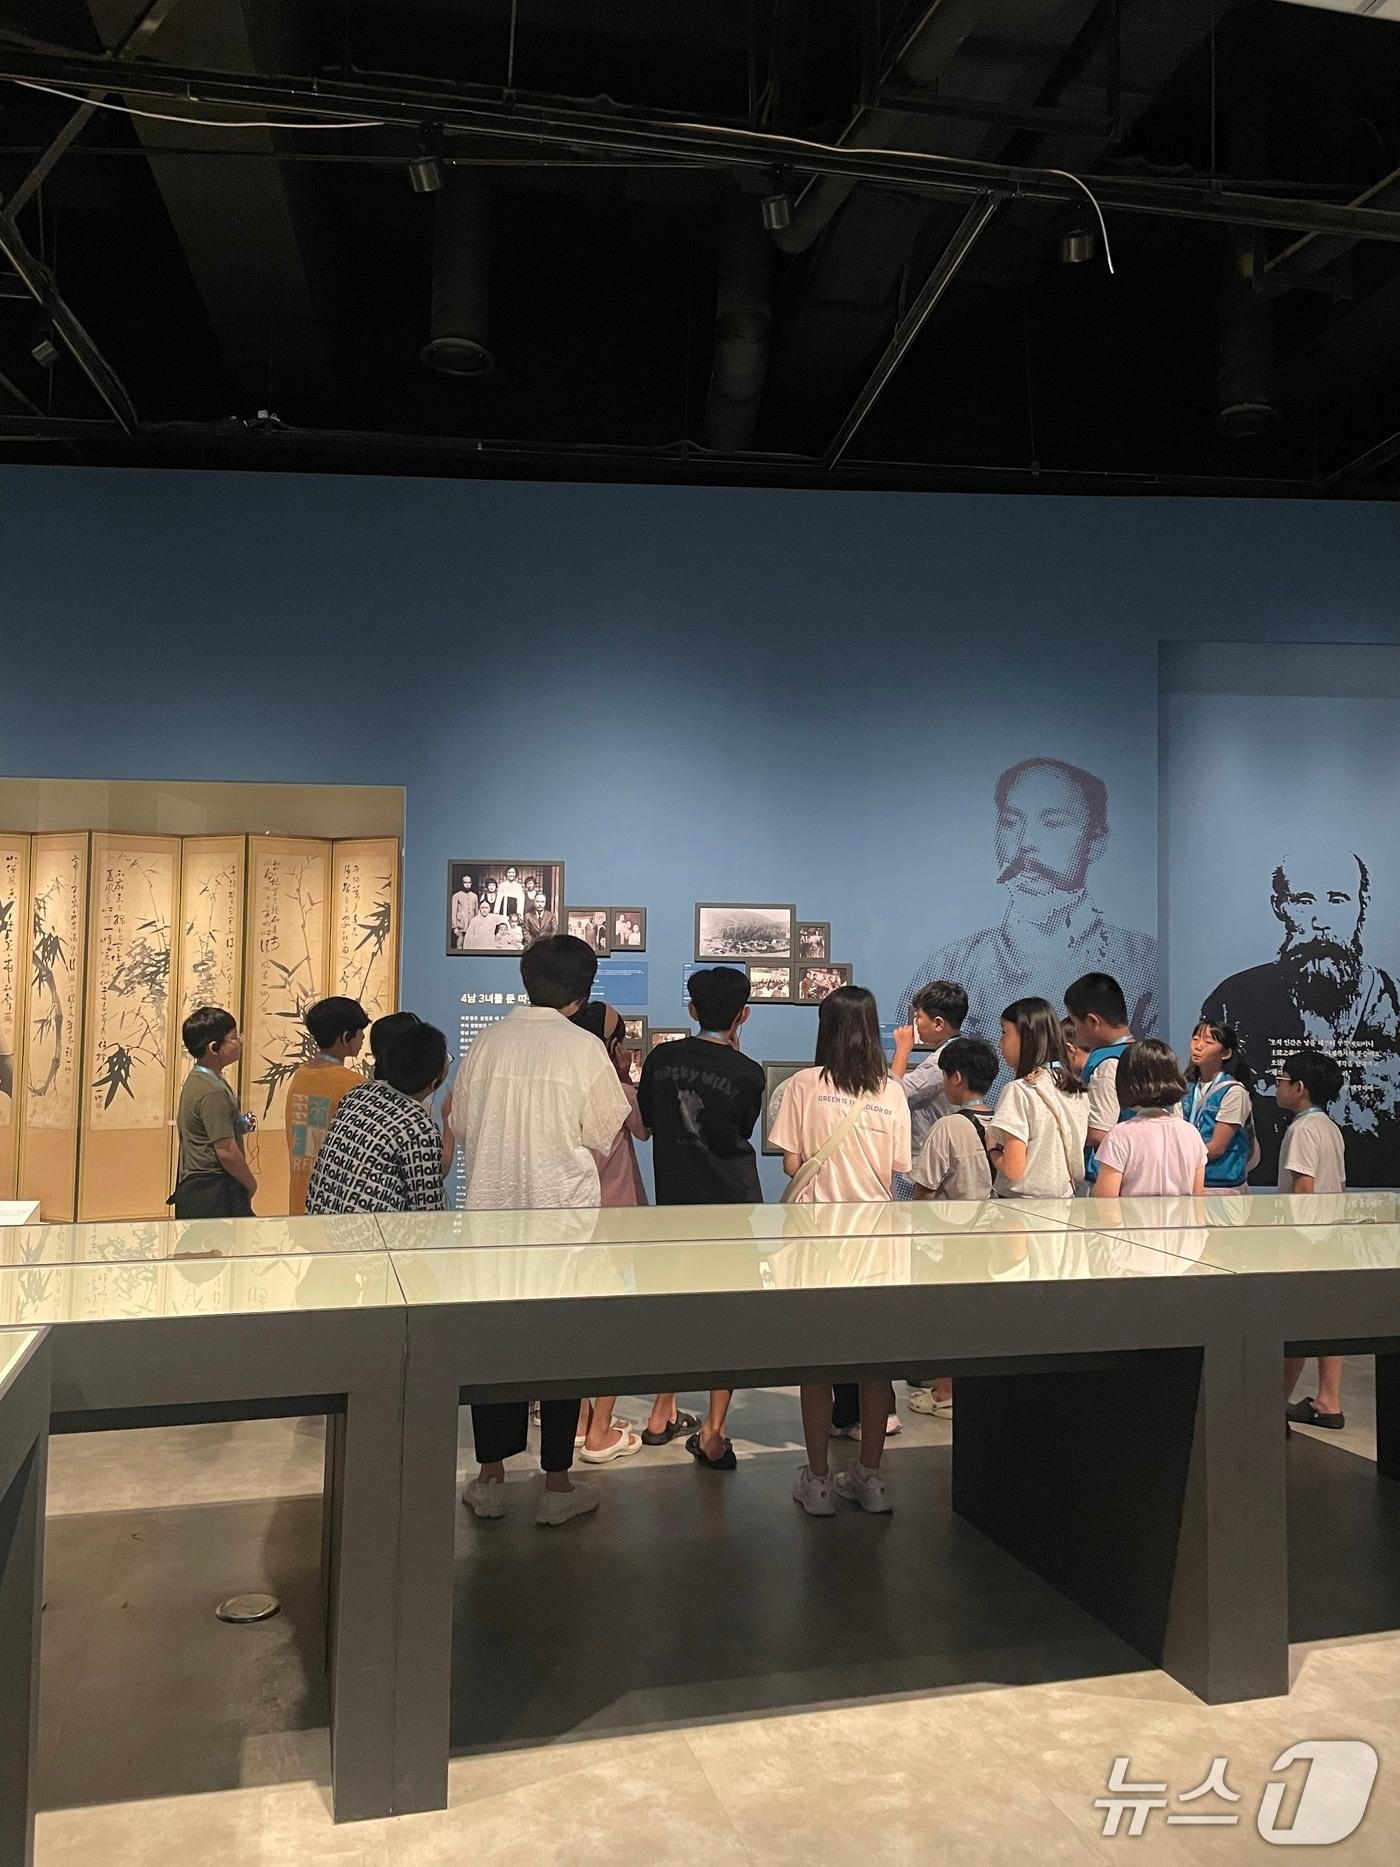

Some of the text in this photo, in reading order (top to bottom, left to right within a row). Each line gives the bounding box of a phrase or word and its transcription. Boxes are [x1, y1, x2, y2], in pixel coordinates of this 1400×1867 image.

[460, 993, 477, 1004] 4남
[517, 993, 531, 1005] 따
[818, 1095, 841, 1103] GREEN
[841, 1097, 848, 1105] IS
[863, 1103, 884, 1113] OLOR
[884, 1108, 893, 1116] OF
